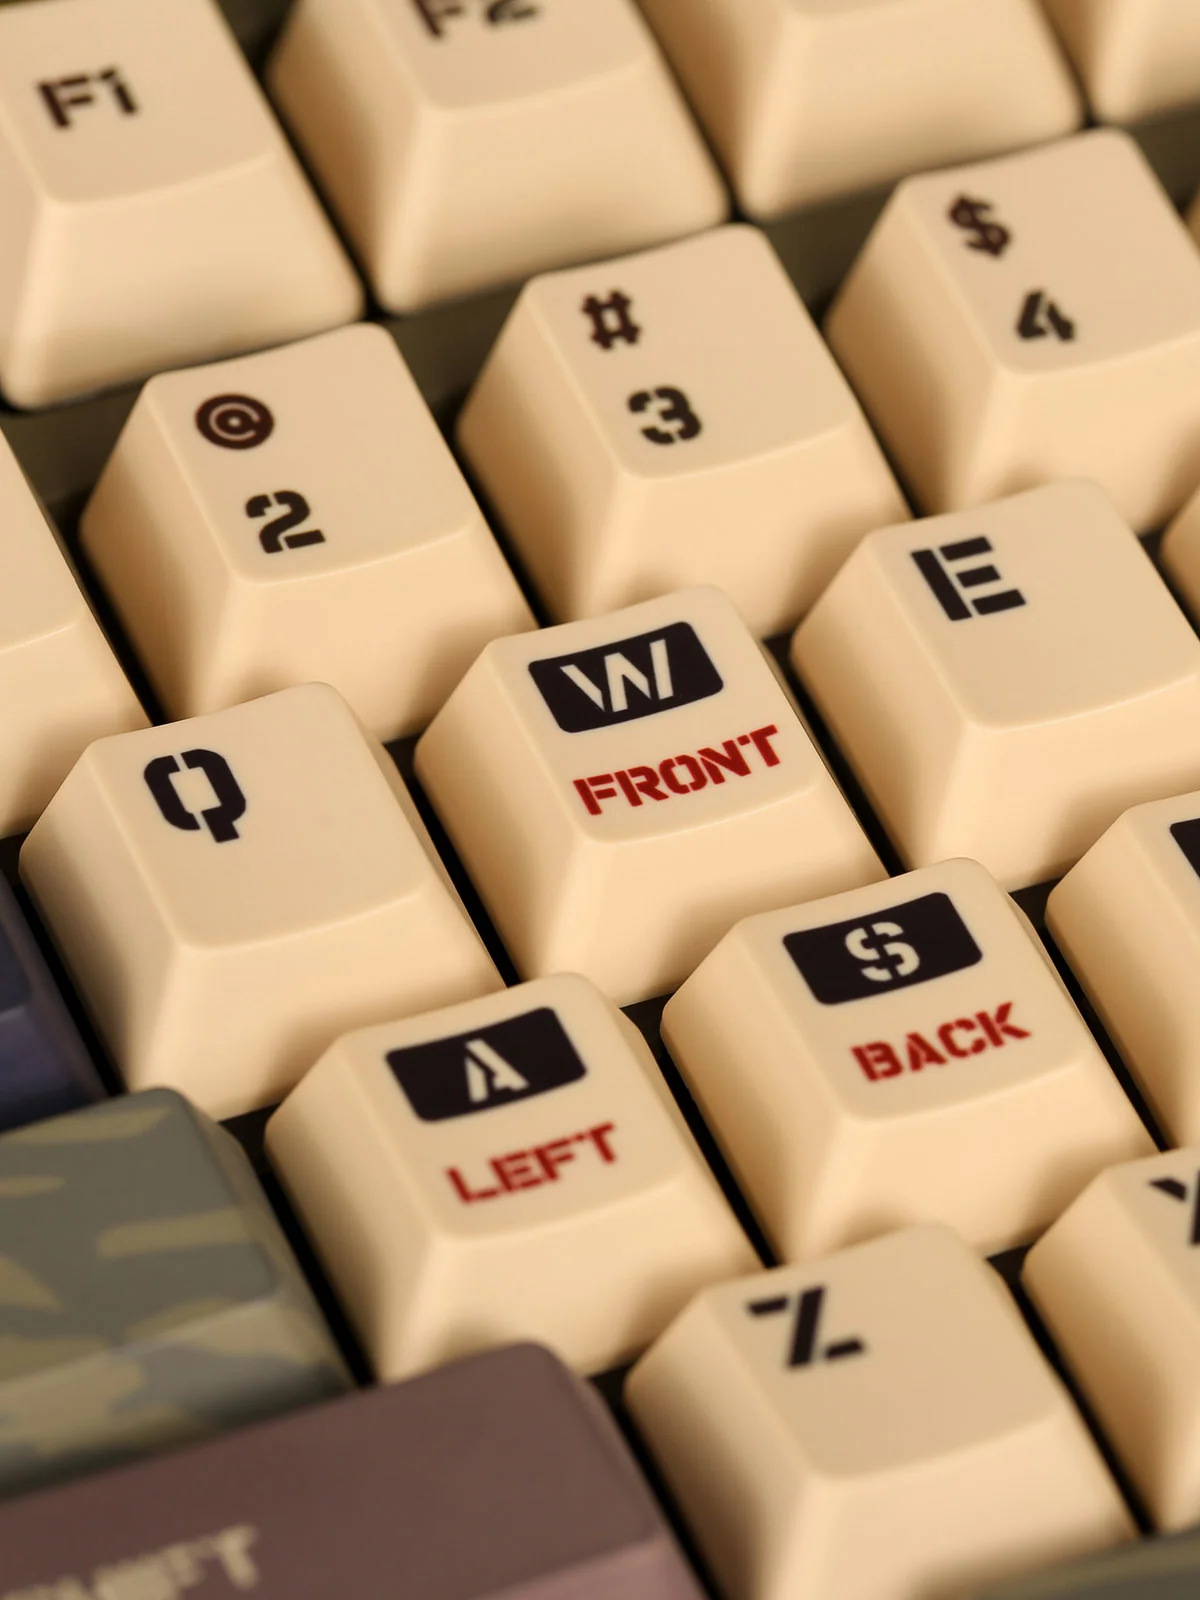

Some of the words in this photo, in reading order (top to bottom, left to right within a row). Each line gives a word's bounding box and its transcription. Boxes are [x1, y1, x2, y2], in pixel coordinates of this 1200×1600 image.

[37, 68, 137, 129] F1
[948, 195, 1011, 258] $
[581, 290, 641, 350] #
[1015, 290, 1075, 342] 4
[195, 394, 275, 450] @
[627, 386, 702, 445] 3
[245, 490, 325, 554] 2
[910, 536, 1026, 621] E
[560, 638, 676, 713] W
[144, 749, 246, 843] Q
[573, 724, 780, 815] FRONT
[844, 921, 921, 982] S
[463, 1038, 530, 1104] A
[850, 1001, 1031, 1082] BACK
[446, 1122, 616, 1204] LEFT
[747, 1286, 864, 1370] Z
